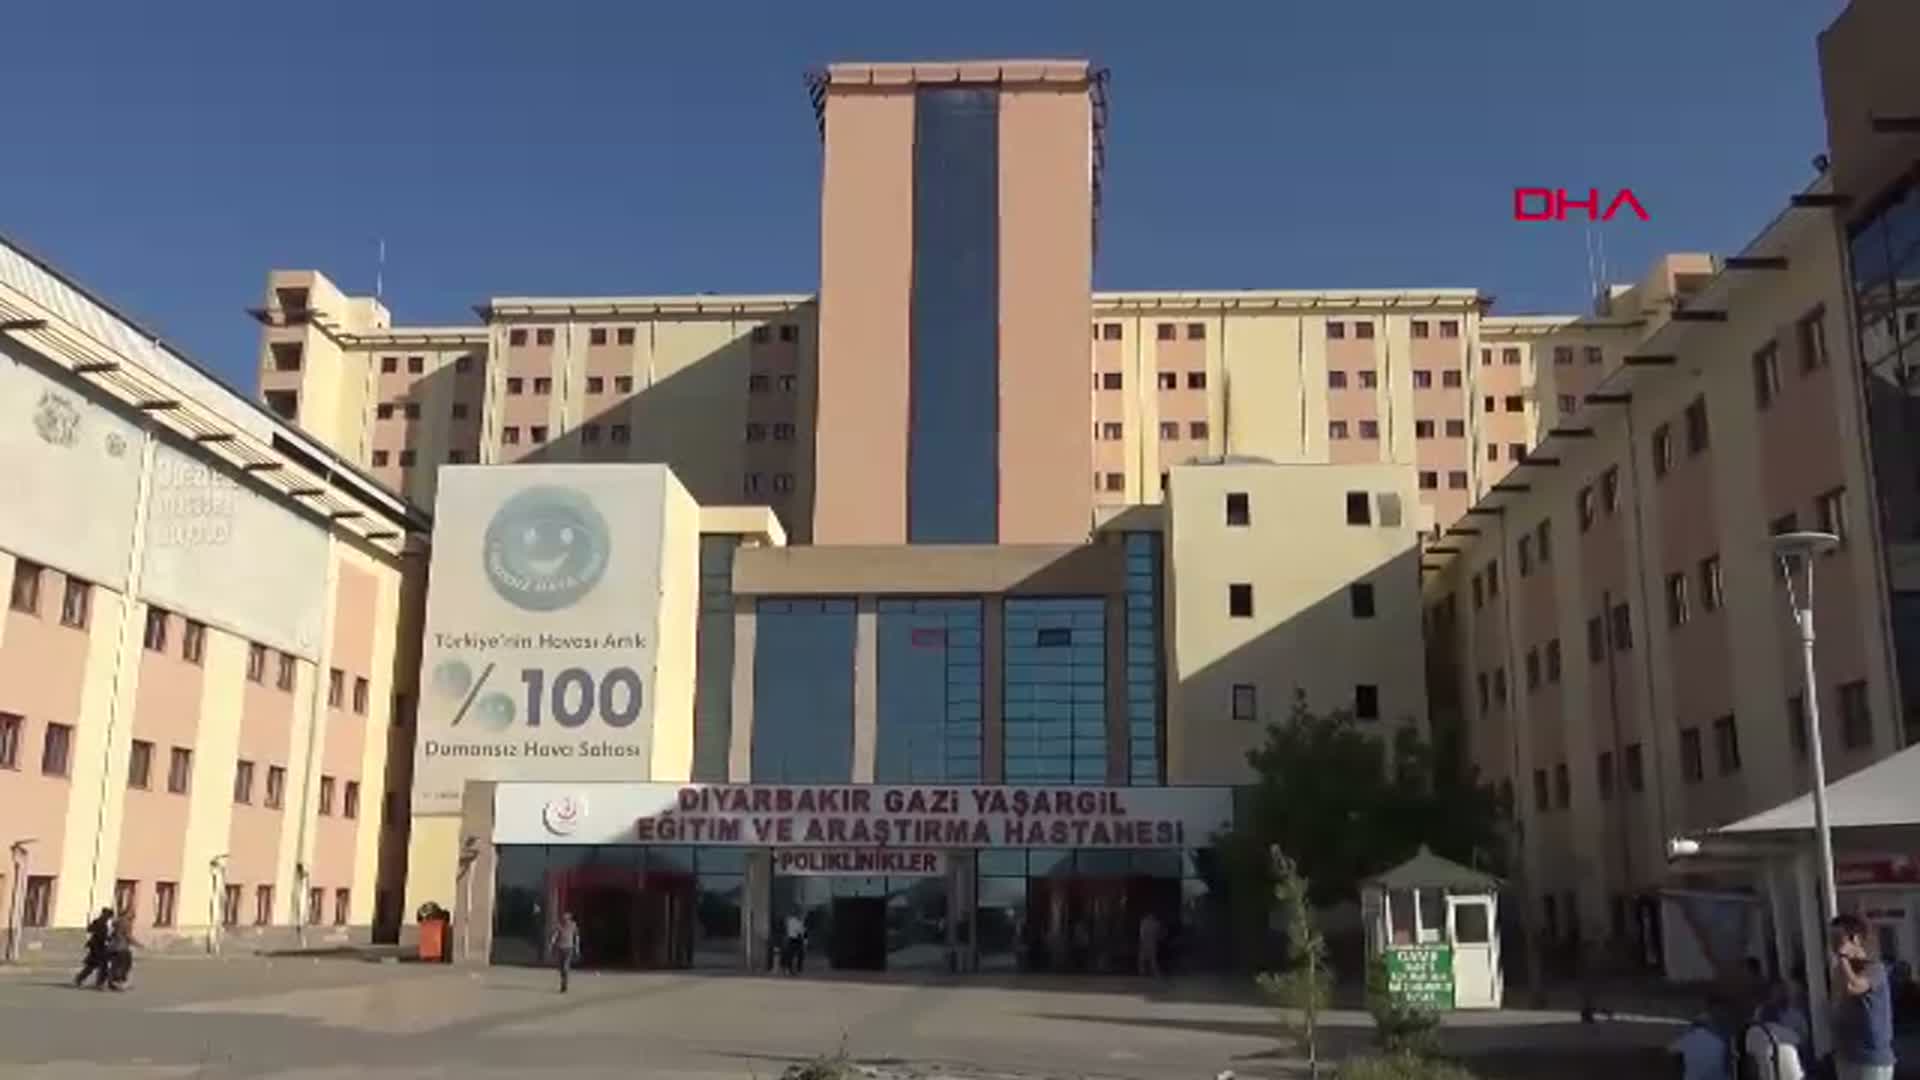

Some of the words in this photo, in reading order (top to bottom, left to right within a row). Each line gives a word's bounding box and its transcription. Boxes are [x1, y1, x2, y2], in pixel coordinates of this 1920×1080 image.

[425, 740, 517, 757] Dumansız
[523, 740, 573, 757] Hava
[578, 740, 641, 757] Sahası
[752, 818, 794, 842] VE
[804, 818, 991, 847] ARAŞTIRMA
